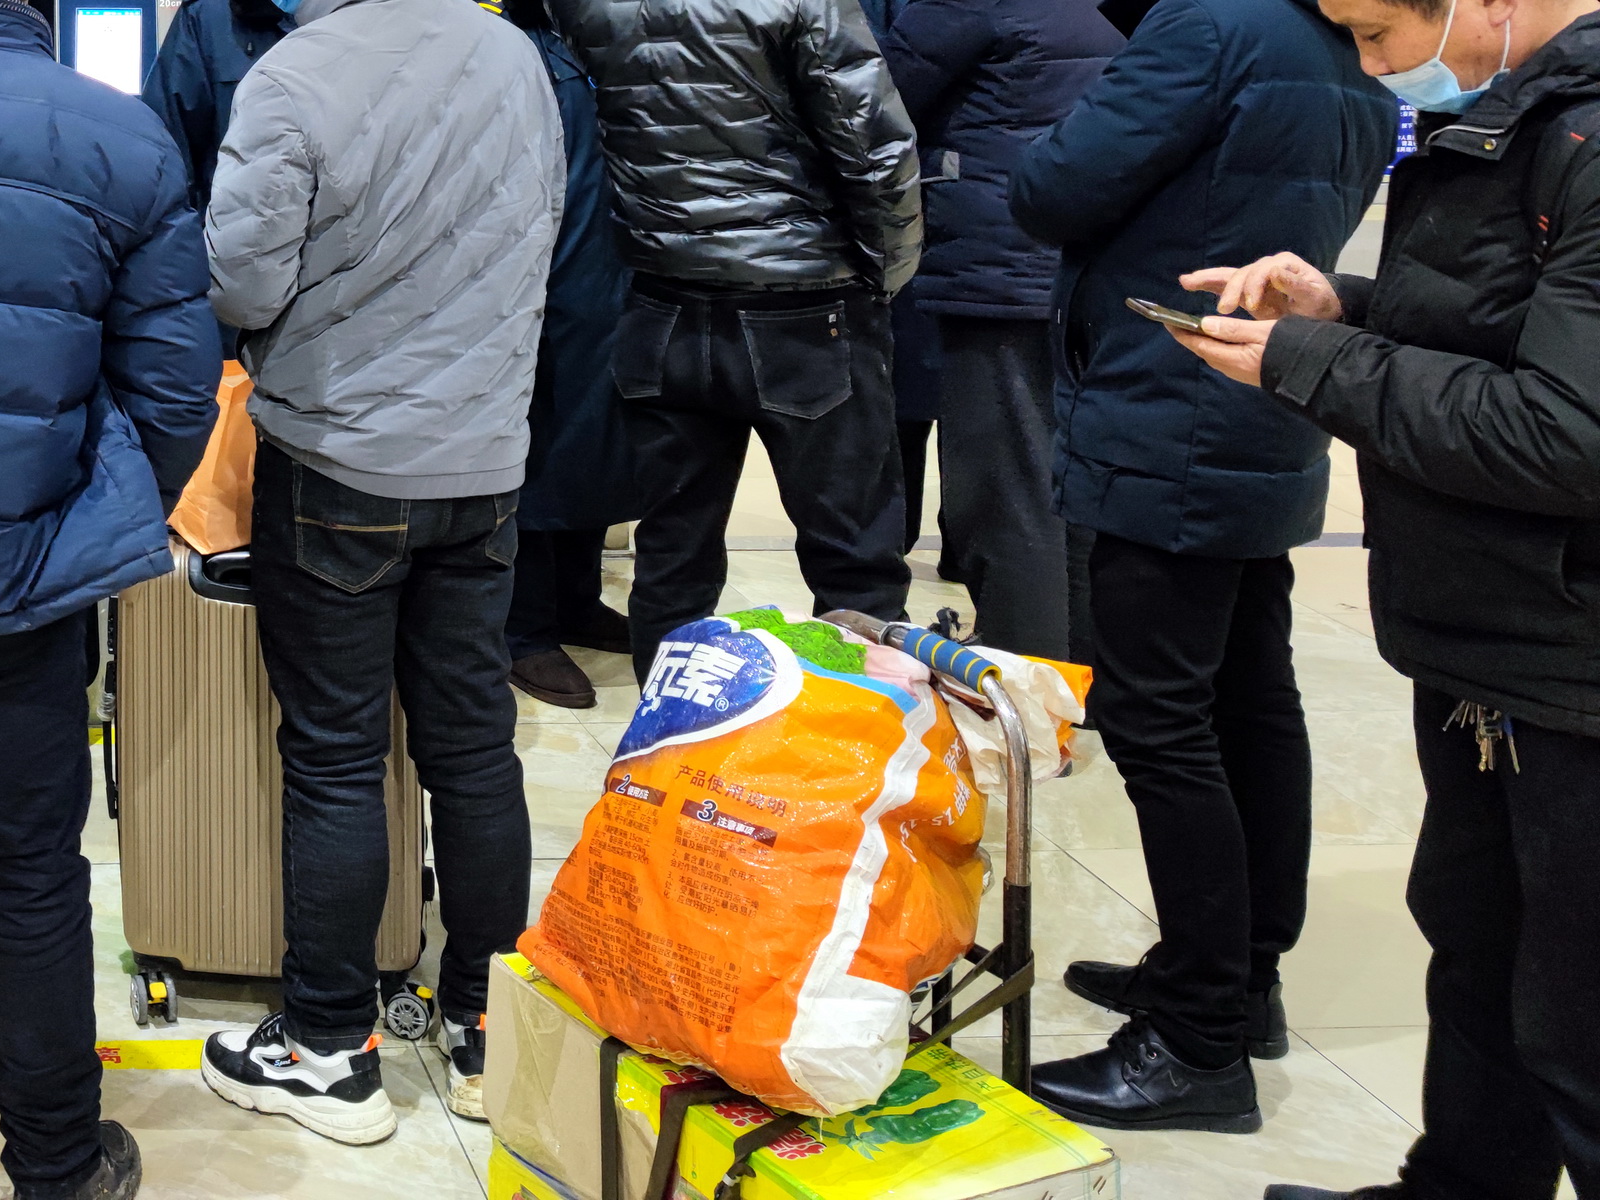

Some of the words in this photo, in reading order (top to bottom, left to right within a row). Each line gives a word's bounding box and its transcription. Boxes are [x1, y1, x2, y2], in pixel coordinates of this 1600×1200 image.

[674, 763, 788, 819] 产品使用说明
[696, 799, 718, 822] 3
